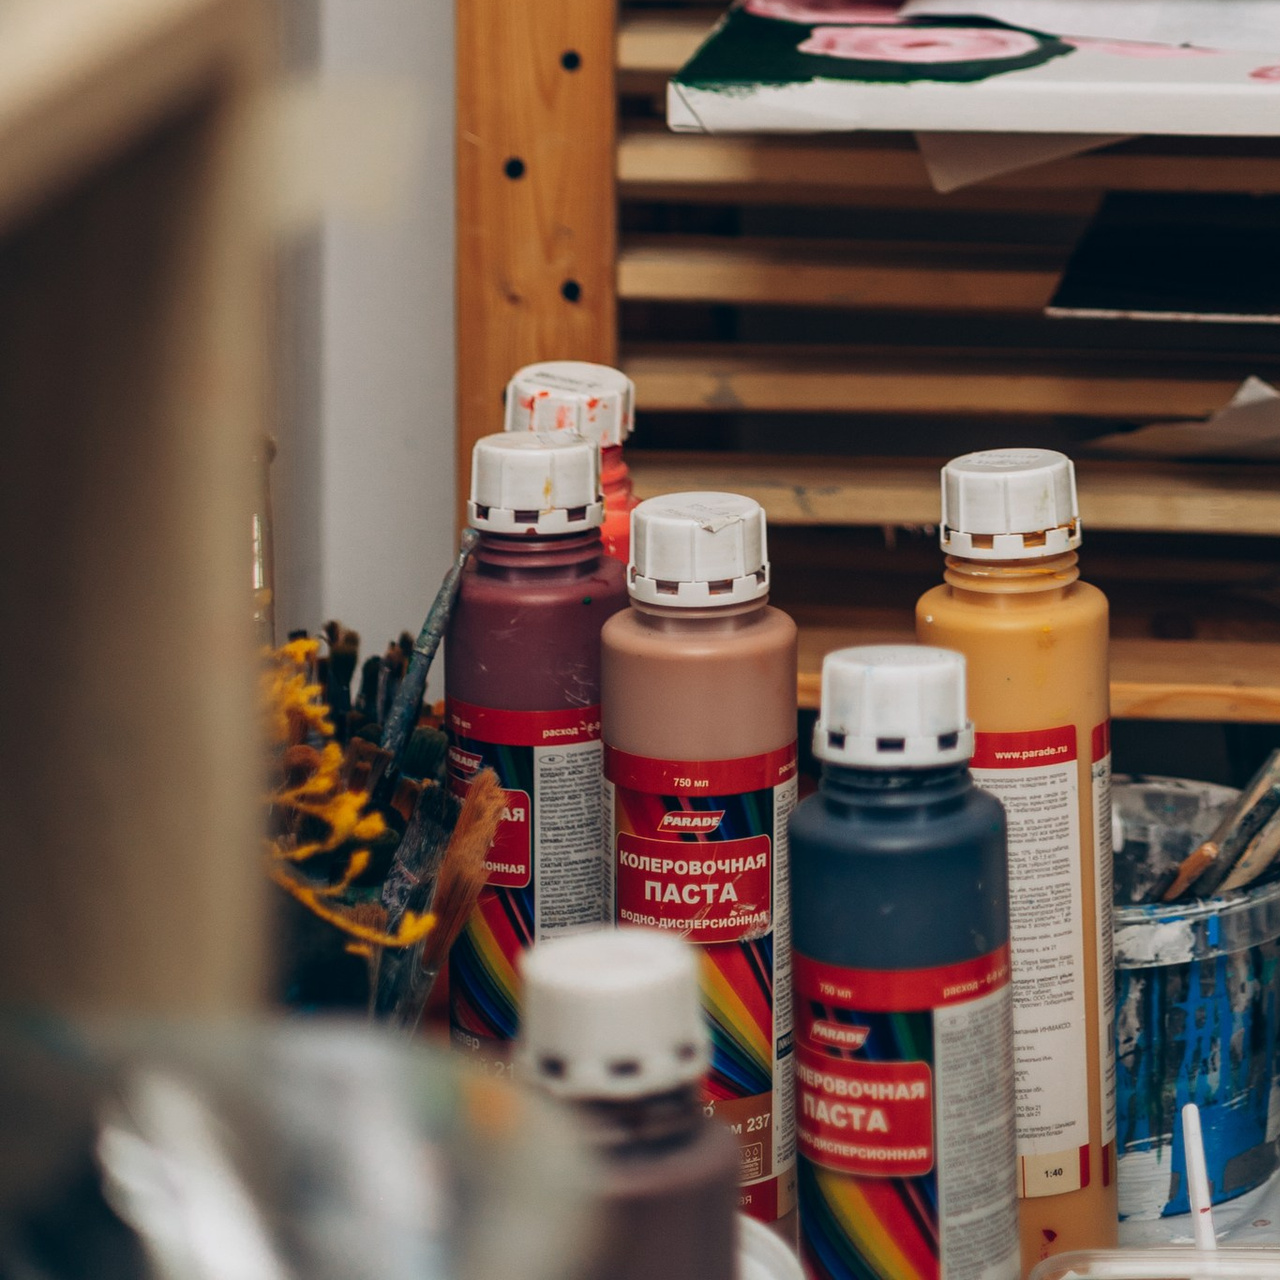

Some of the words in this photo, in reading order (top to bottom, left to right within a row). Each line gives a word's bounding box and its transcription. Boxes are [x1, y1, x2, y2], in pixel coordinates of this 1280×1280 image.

[994, 745, 1068, 760] www.parade.ru
[673, 777, 691, 788] 750
[694, 779, 709, 788] мл
[663, 815, 720, 827] PARADE
[619, 850, 767, 876] КОЛЕРОВОЧНАЯ
[644, 880, 738, 905] ПАСТА
[620, 908, 768, 930] ВОДНО-ДИСПЕРСИОННАЯ
[819, 983, 835, 996] 750
[836, 987, 852, 999] мл
[943, 981, 978, 999] расход
[812, 1024, 865, 1044] PARADE
[797, 1065, 926, 1100] ЛЕРОВОЧНАЯ
[803, 1092, 889, 1133] ПАСТА
[747, 1113, 771, 1133] 237
[1044, 1167, 1063, 1178] 1:40
